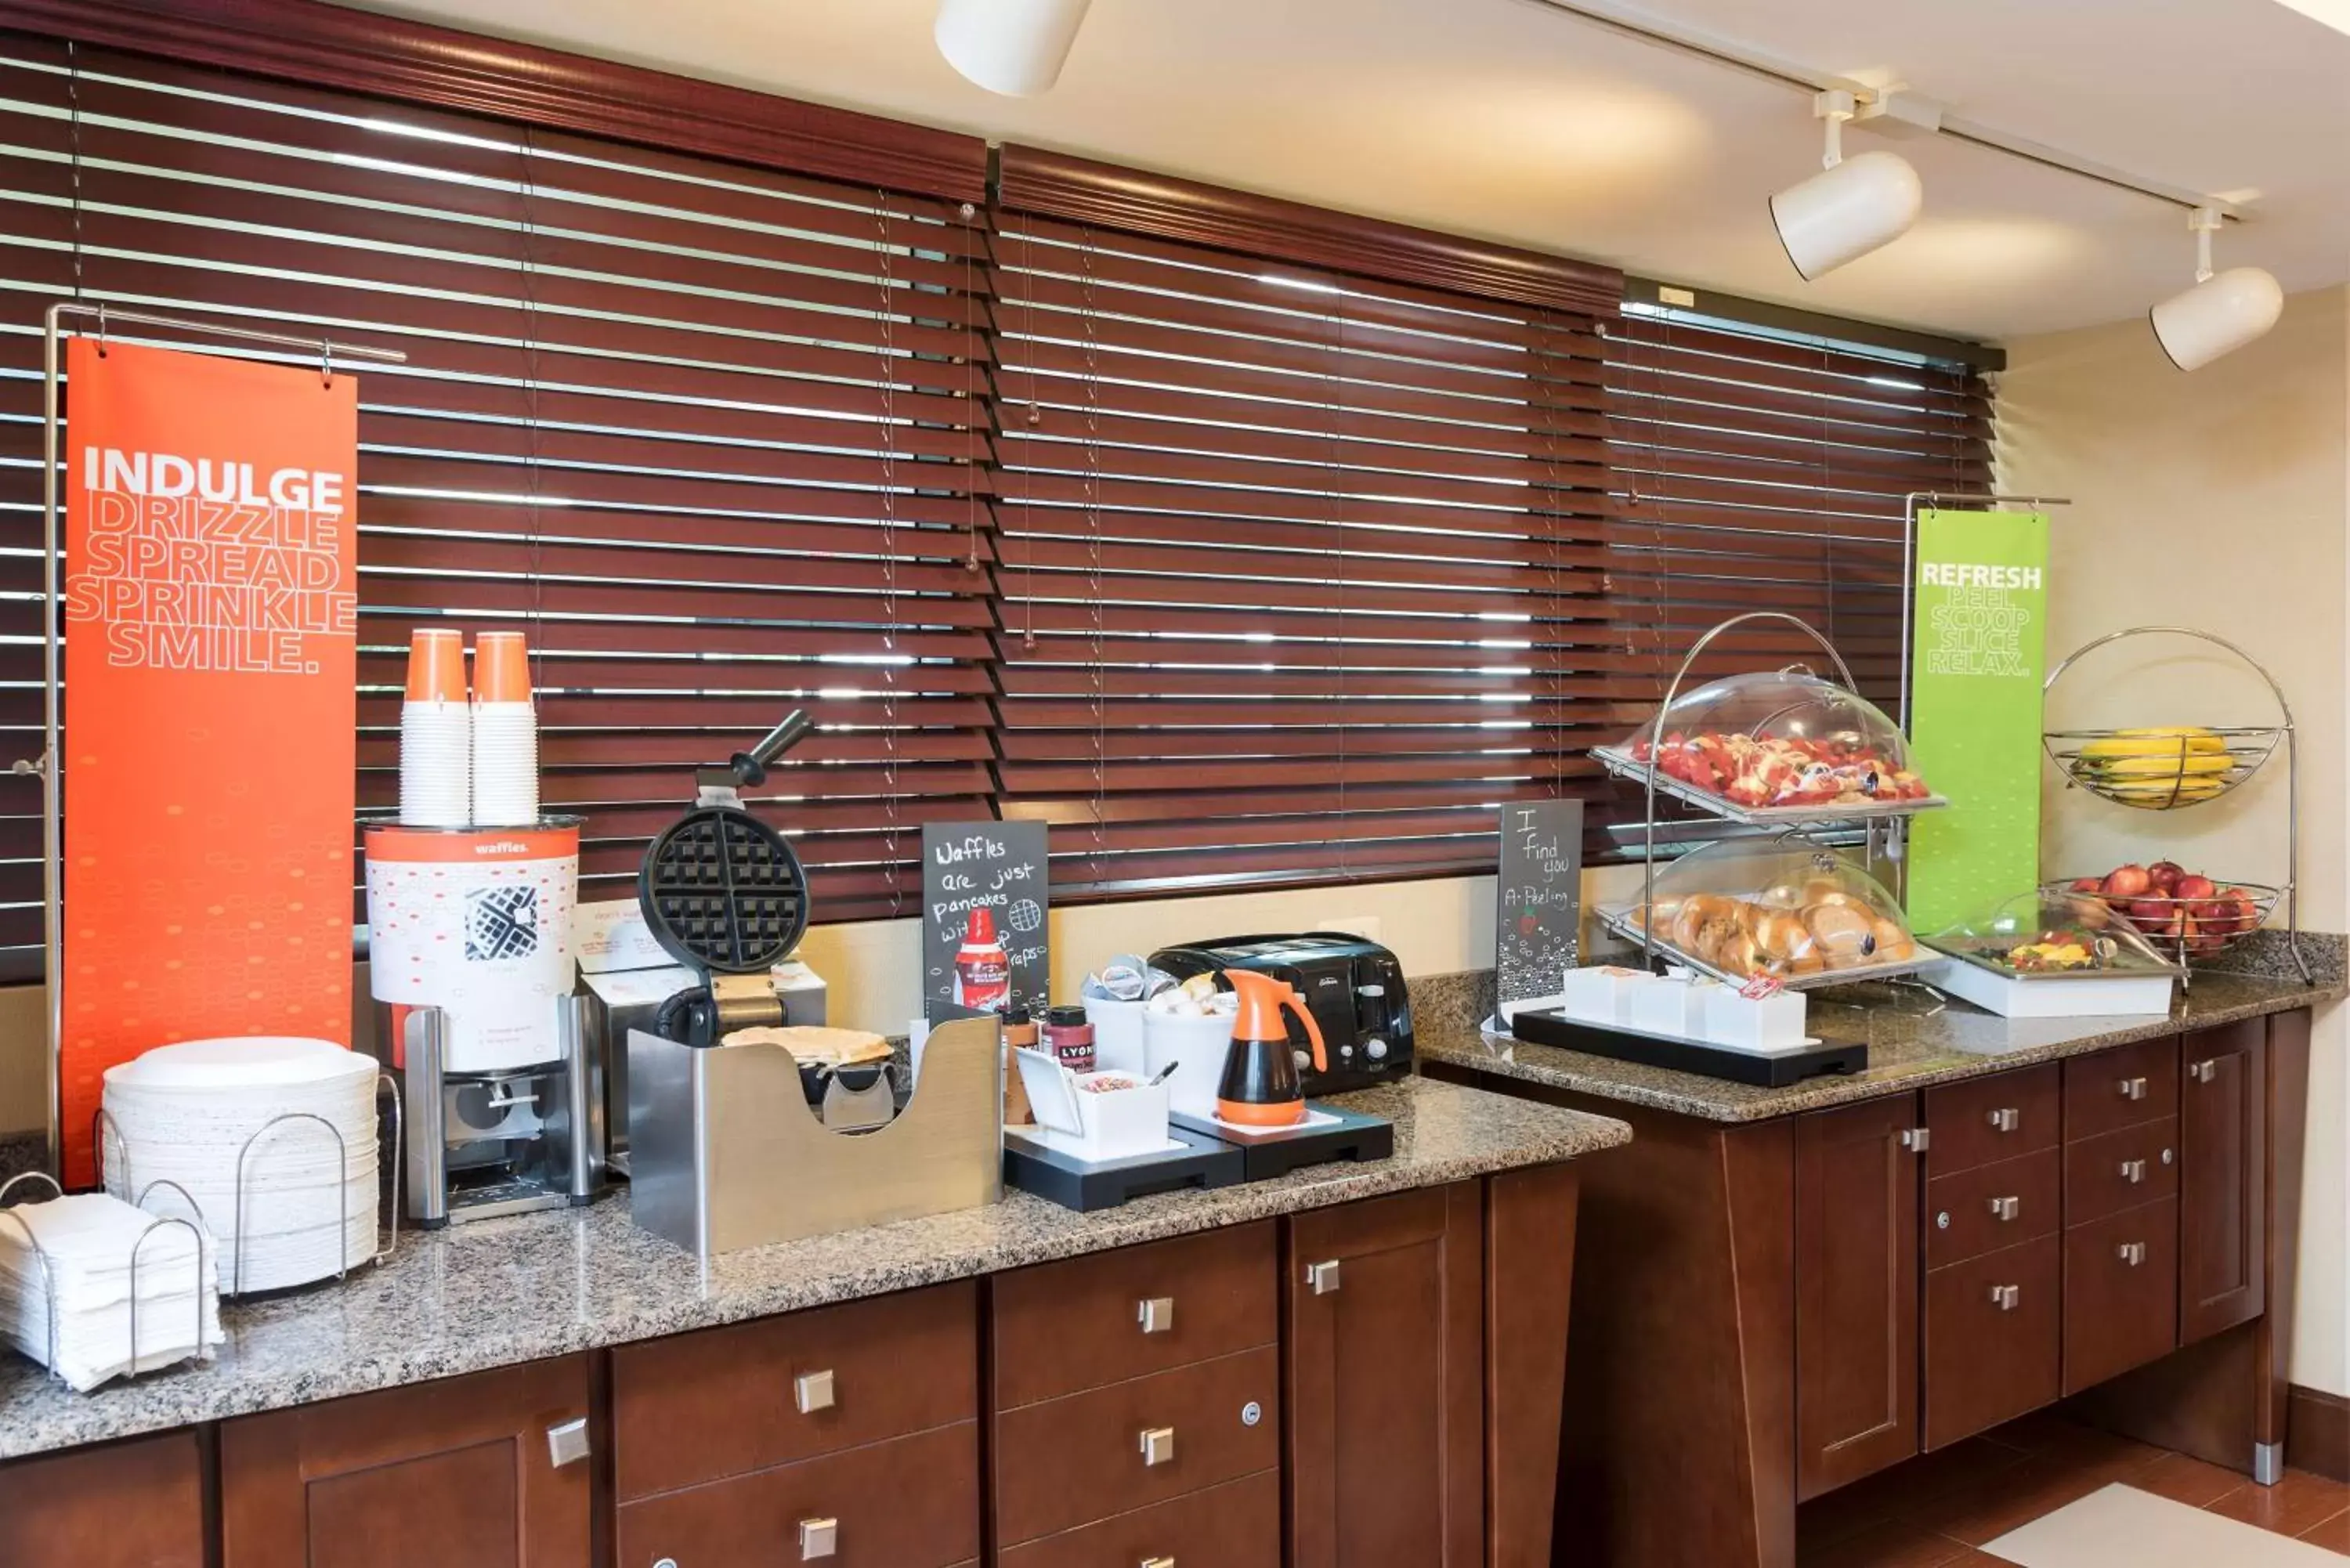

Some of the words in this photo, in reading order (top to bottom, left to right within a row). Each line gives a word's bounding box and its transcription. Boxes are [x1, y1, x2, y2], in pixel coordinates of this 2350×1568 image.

[85, 446, 343, 513] INDULGE
[89, 489, 339, 553] DRIZZLE
[86, 532, 340, 592] SPREAD
[1922, 563, 2041, 589] REFRESH
[66, 573, 357, 635] SPRINKLE
[1947, 586, 2015, 608] PEEL
[1931, 605, 2030, 631] SCOOP
[108, 620, 320, 674] SMILE.
[1940, 628, 2019, 652] SLICE
[1928, 649, 2030, 677] RELAX.
[1517, 809, 1537, 833] I
[935, 836, 1006, 865] Waffles
[942, 874, 978, 891] are
[989, 862, 1036, 890] just
[1542, 858, 1569, 883] you
[931, 893, 1009, 923] pancakes
